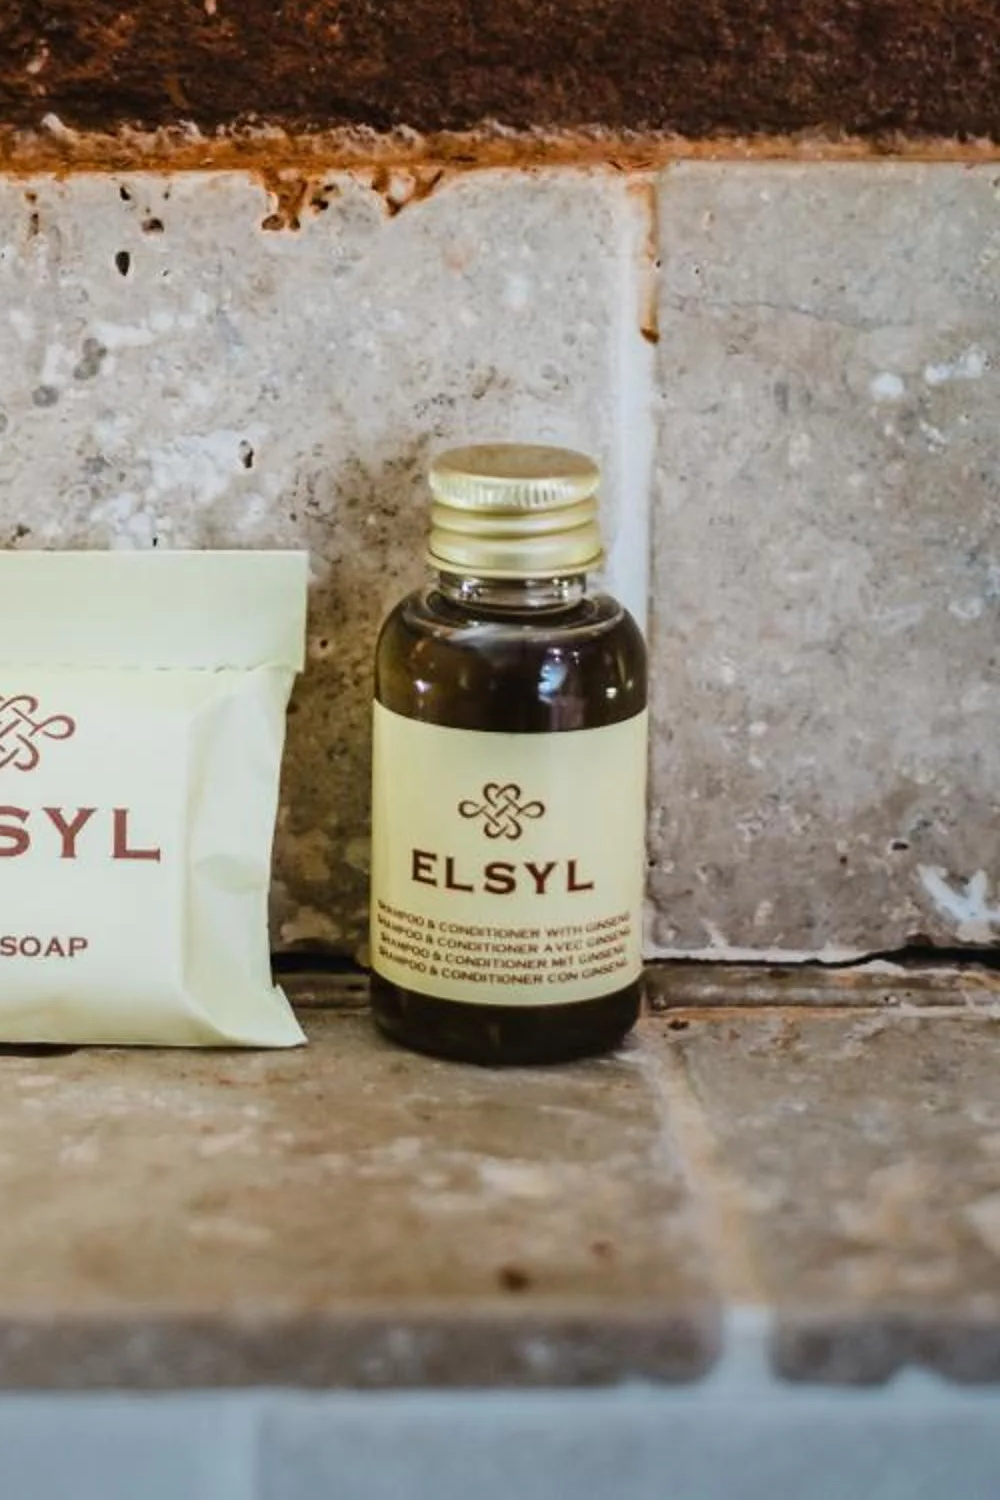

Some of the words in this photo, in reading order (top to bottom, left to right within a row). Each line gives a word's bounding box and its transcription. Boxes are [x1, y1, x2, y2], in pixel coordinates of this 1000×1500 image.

[411, 849, 594, 895] ELSYL
[439, 921, 541, 939] CONDITIONER
[545, 925, 583, 937] WITH
[0, 936, 88, 957] SOAP
[436, 936, 538, 953] CONDITIONER
[544, 940, 583, 952] AVEC
[444, 953, 548, 969] CONDITIONER
[551, 956, 575, 968] MIT
[441, 968, 544, 985] CONDITIONER
[547, 971, 579, 984] CON
